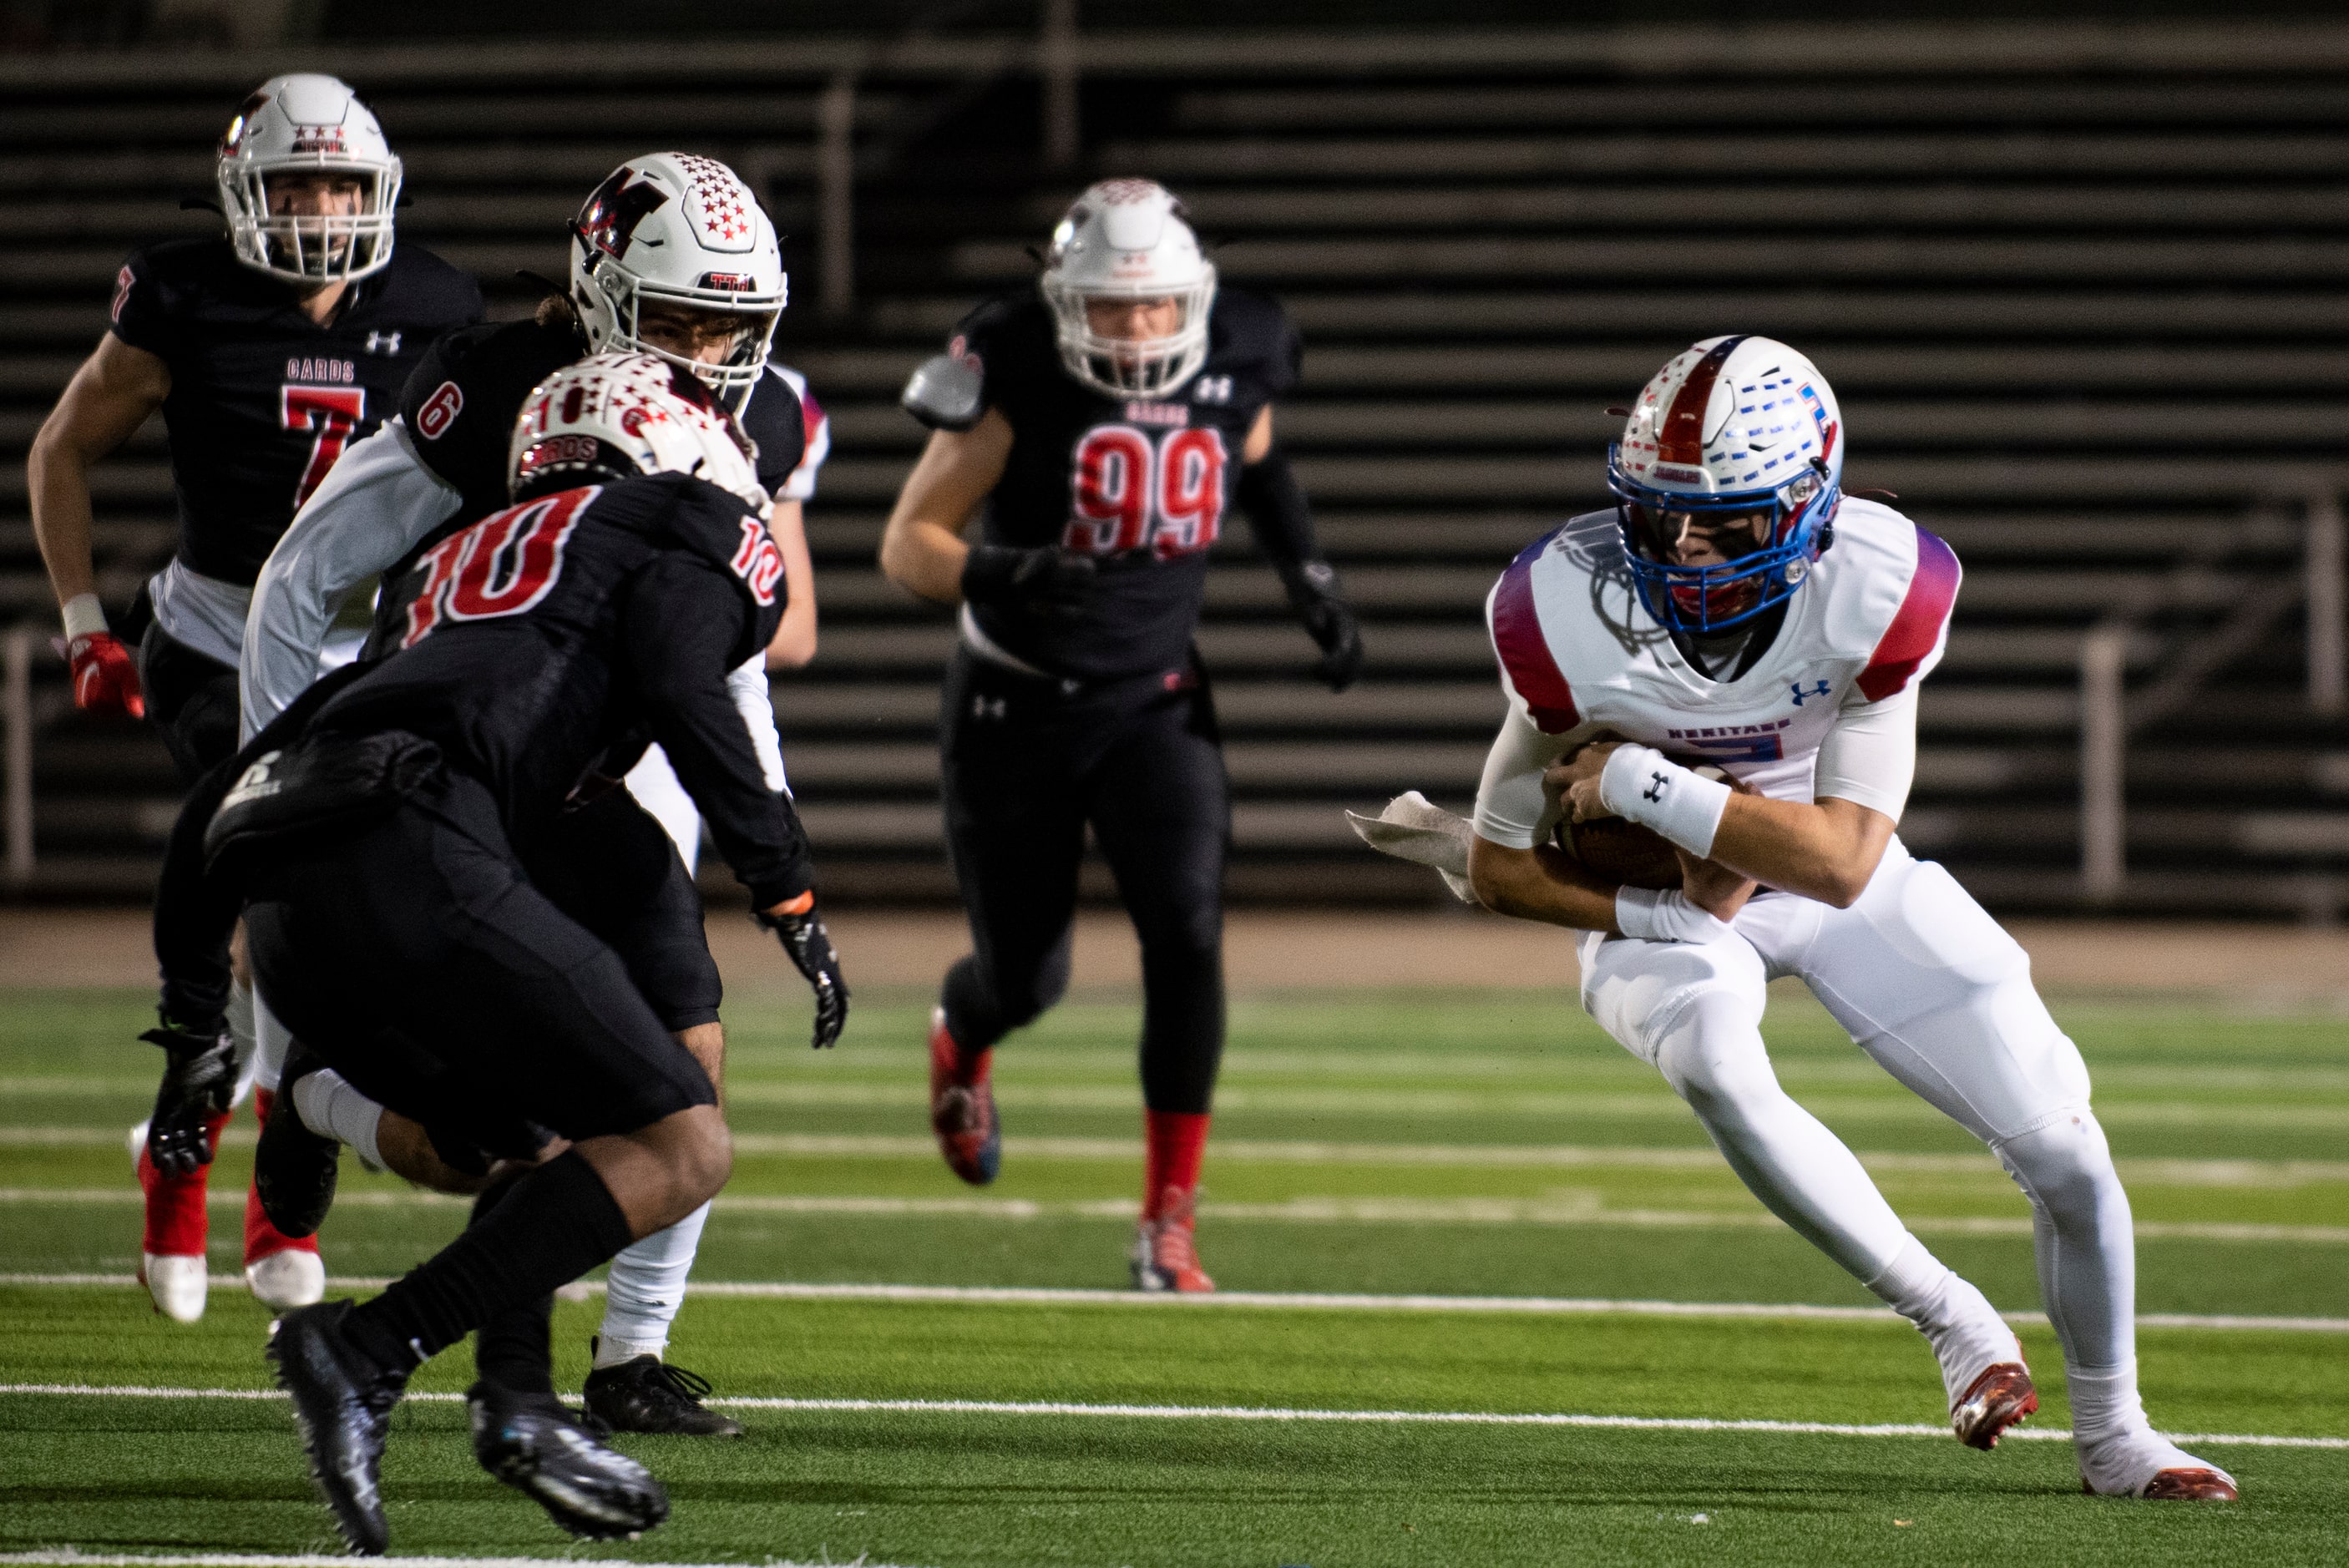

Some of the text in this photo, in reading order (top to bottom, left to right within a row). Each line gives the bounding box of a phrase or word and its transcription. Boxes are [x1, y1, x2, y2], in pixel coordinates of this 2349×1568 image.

[282, 386, 366, 508] 7
[419, 381, 463, 440] 6
[521, 435, 600, 469] RDS
[1062, 424, 1228, 561] 99
[401, 485, 604, 649] 10
